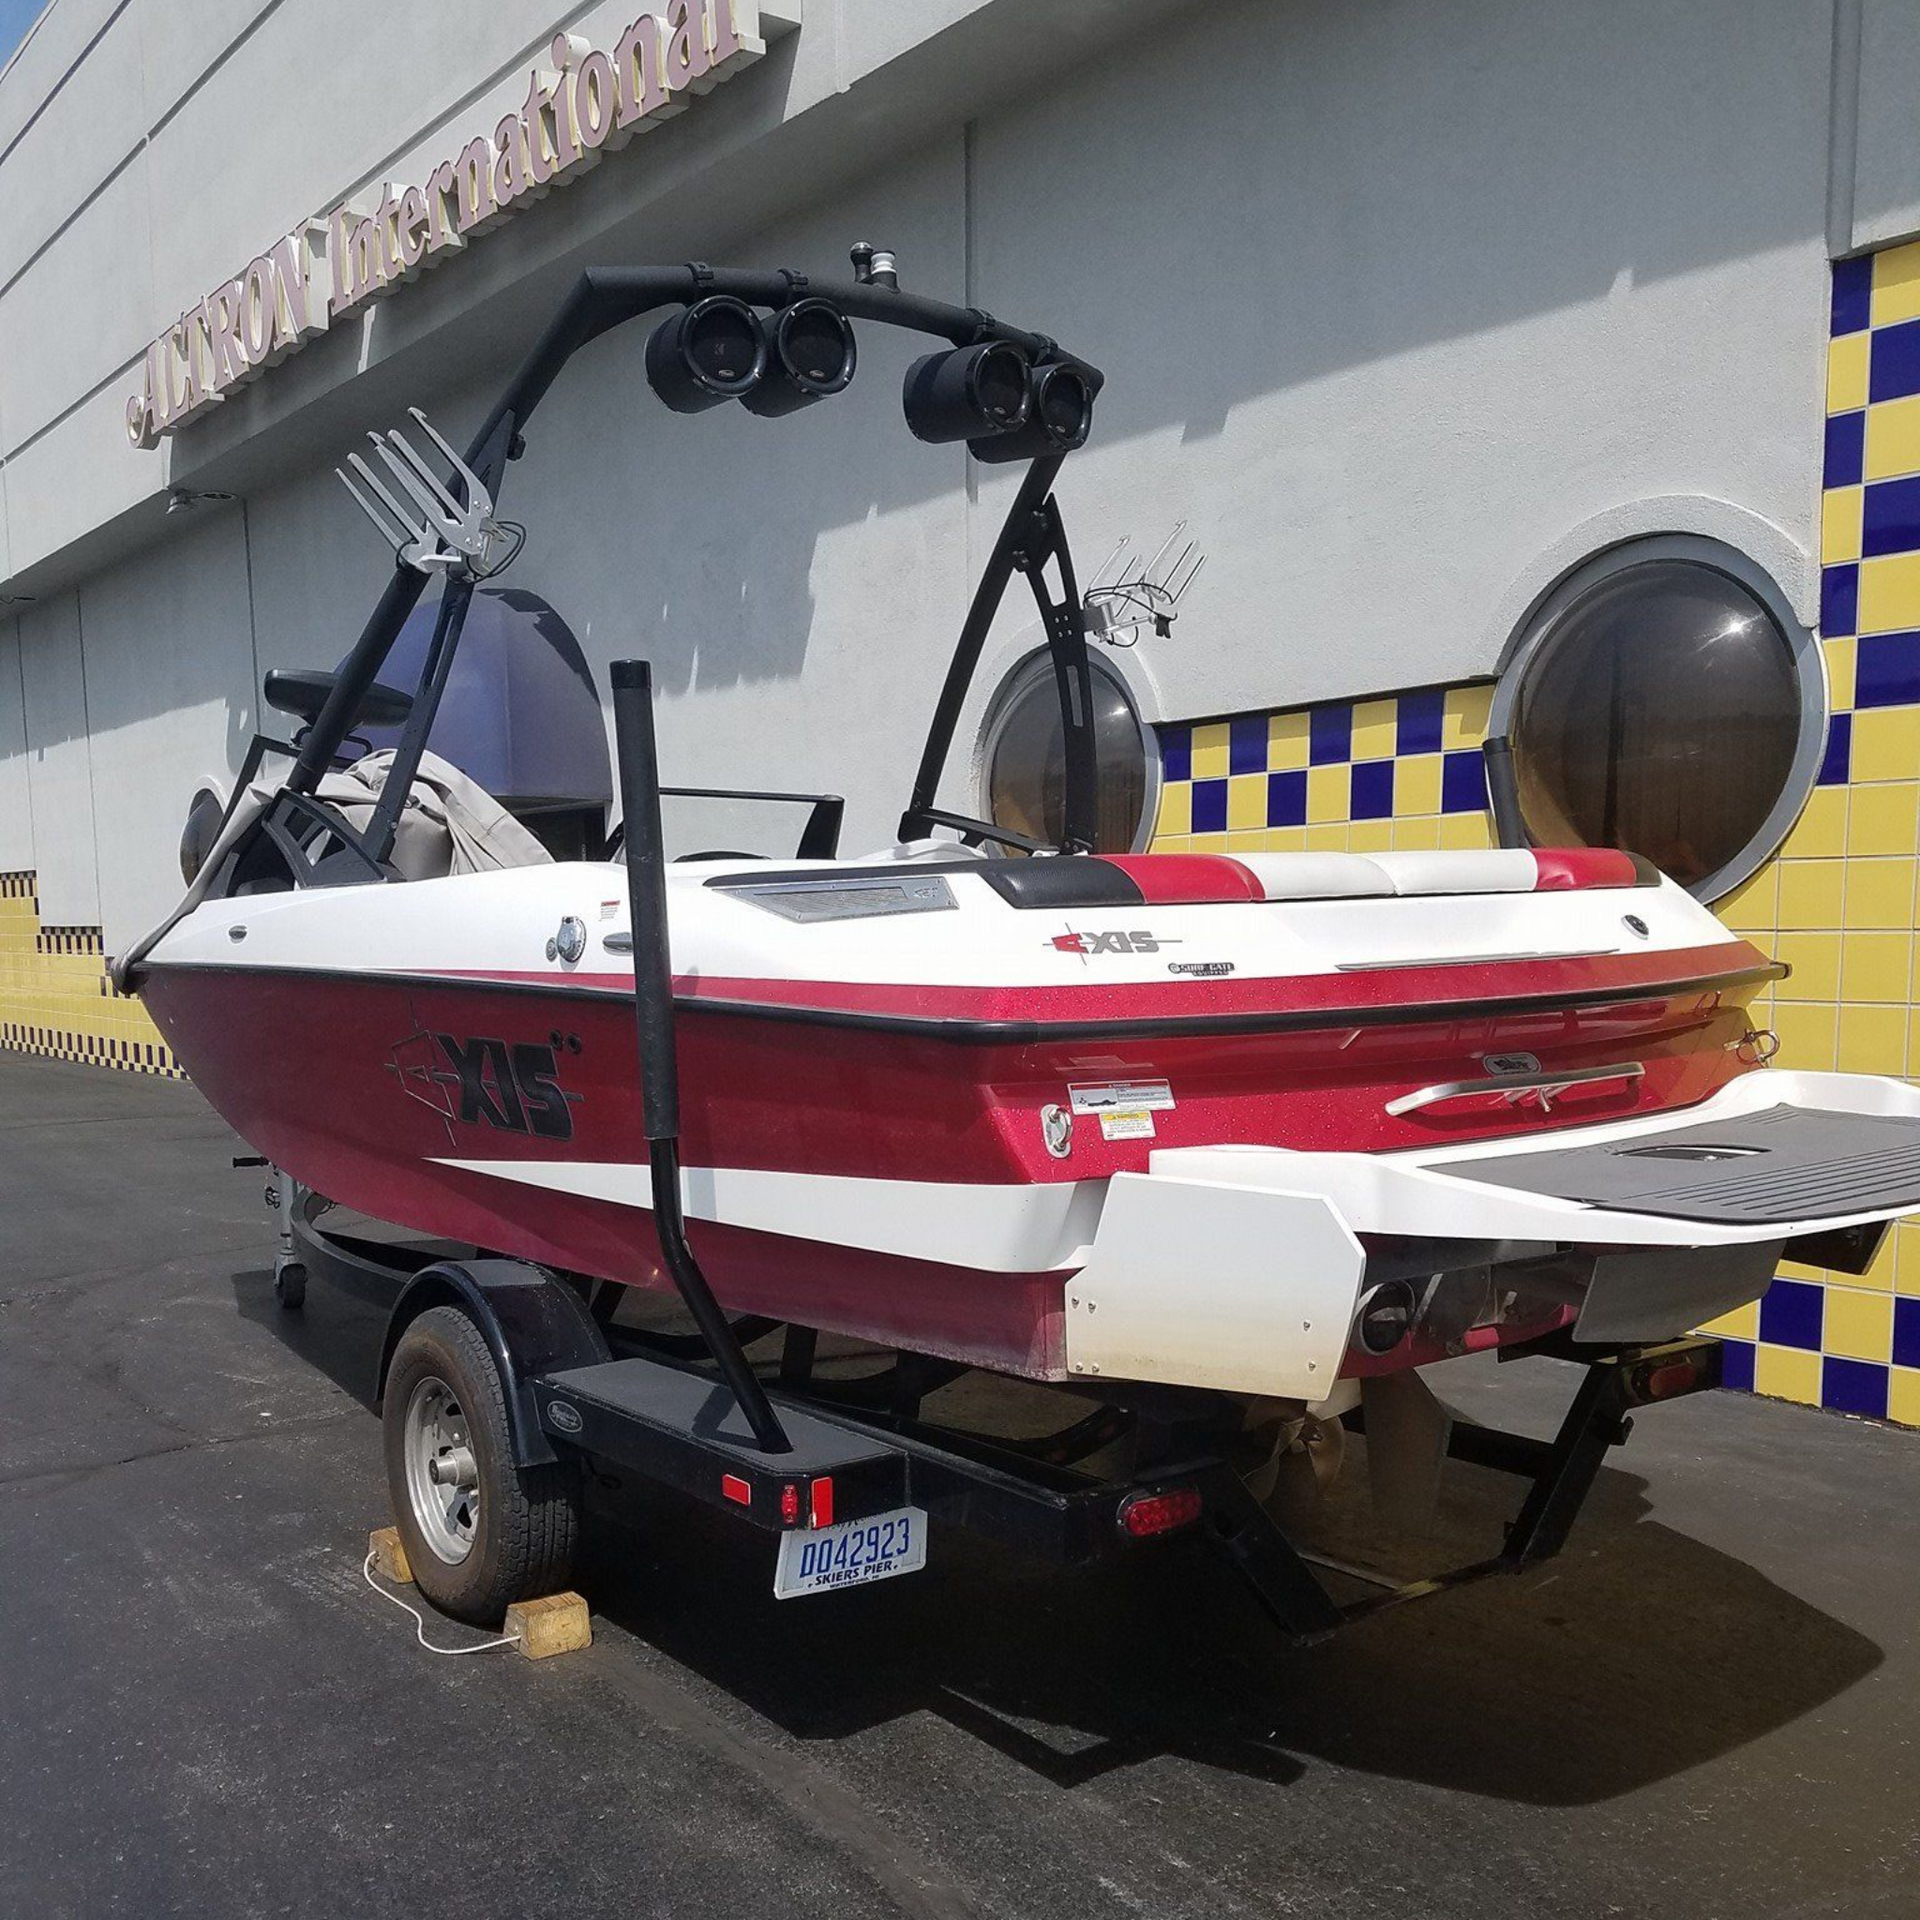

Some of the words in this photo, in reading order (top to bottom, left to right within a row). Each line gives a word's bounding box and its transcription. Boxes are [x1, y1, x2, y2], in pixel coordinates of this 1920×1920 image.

[126, 217, 309, 449] ALTRON
[814, 1567, 860, 1585] SKIERS
[863, 1560, 893, 1577] PIER
